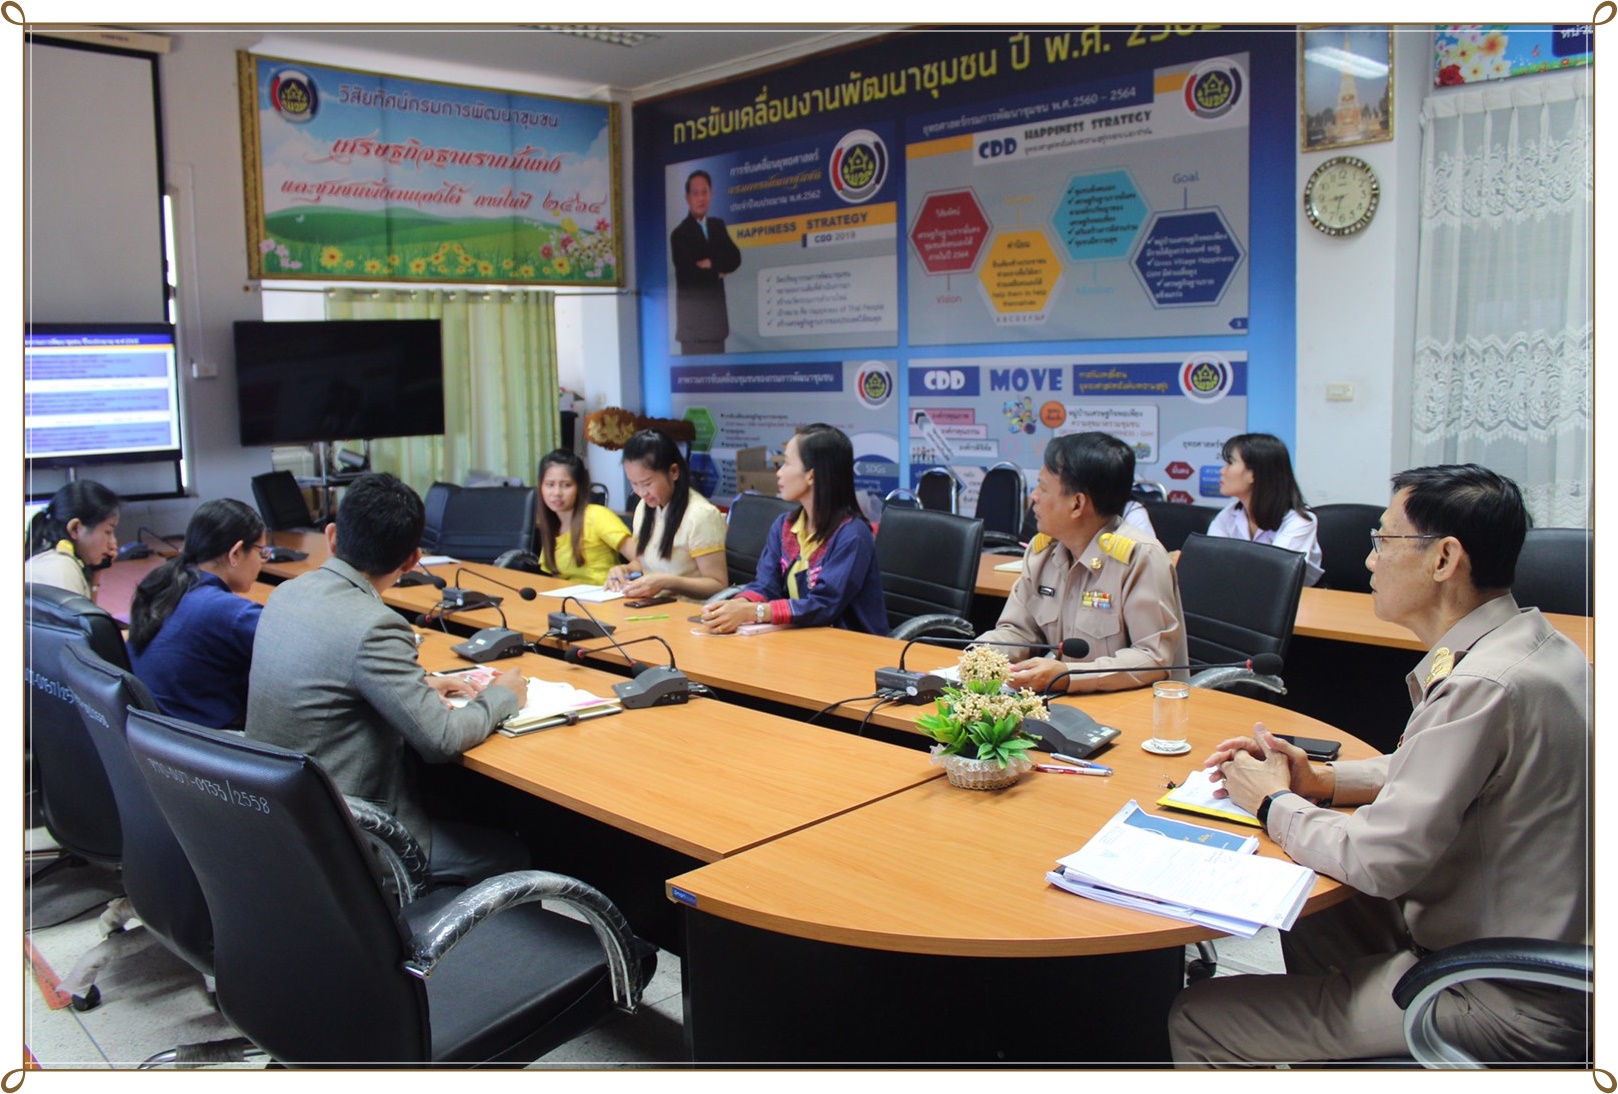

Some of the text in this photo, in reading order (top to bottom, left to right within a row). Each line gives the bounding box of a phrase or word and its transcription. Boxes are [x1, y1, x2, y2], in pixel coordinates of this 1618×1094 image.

[673, 49, 997, 144] การขับเคลื่อนงานพัฒนาชุมชน
[1009, 32, 1030, 70] ปี
[1045, 25, 1111, 64] พ.ศ.
[1110, 86, 1136, 101] 2564
[338, 84, 559, 130] วิสัยทัศน์กรมการพัฒนาชุมชน
[1024, 110, 1152, 140] HAPPINESS STRATEGY
[325, 130, 572, 175] เศรษฐกิจฐานรากมั่นคง
[978, 136, 1018, 159] CDD
[1173, 171, 1199, 184] Goal
[542, 188, 608, 216] ๒๕๖๔
[736, 212, 868, 240] HAPPINESS STRATEGY
[835, 231, 856, 242] 2019
[924, 368, 1063, 392] CDD MOVE
[865, 464, 886, 474] SDGs
